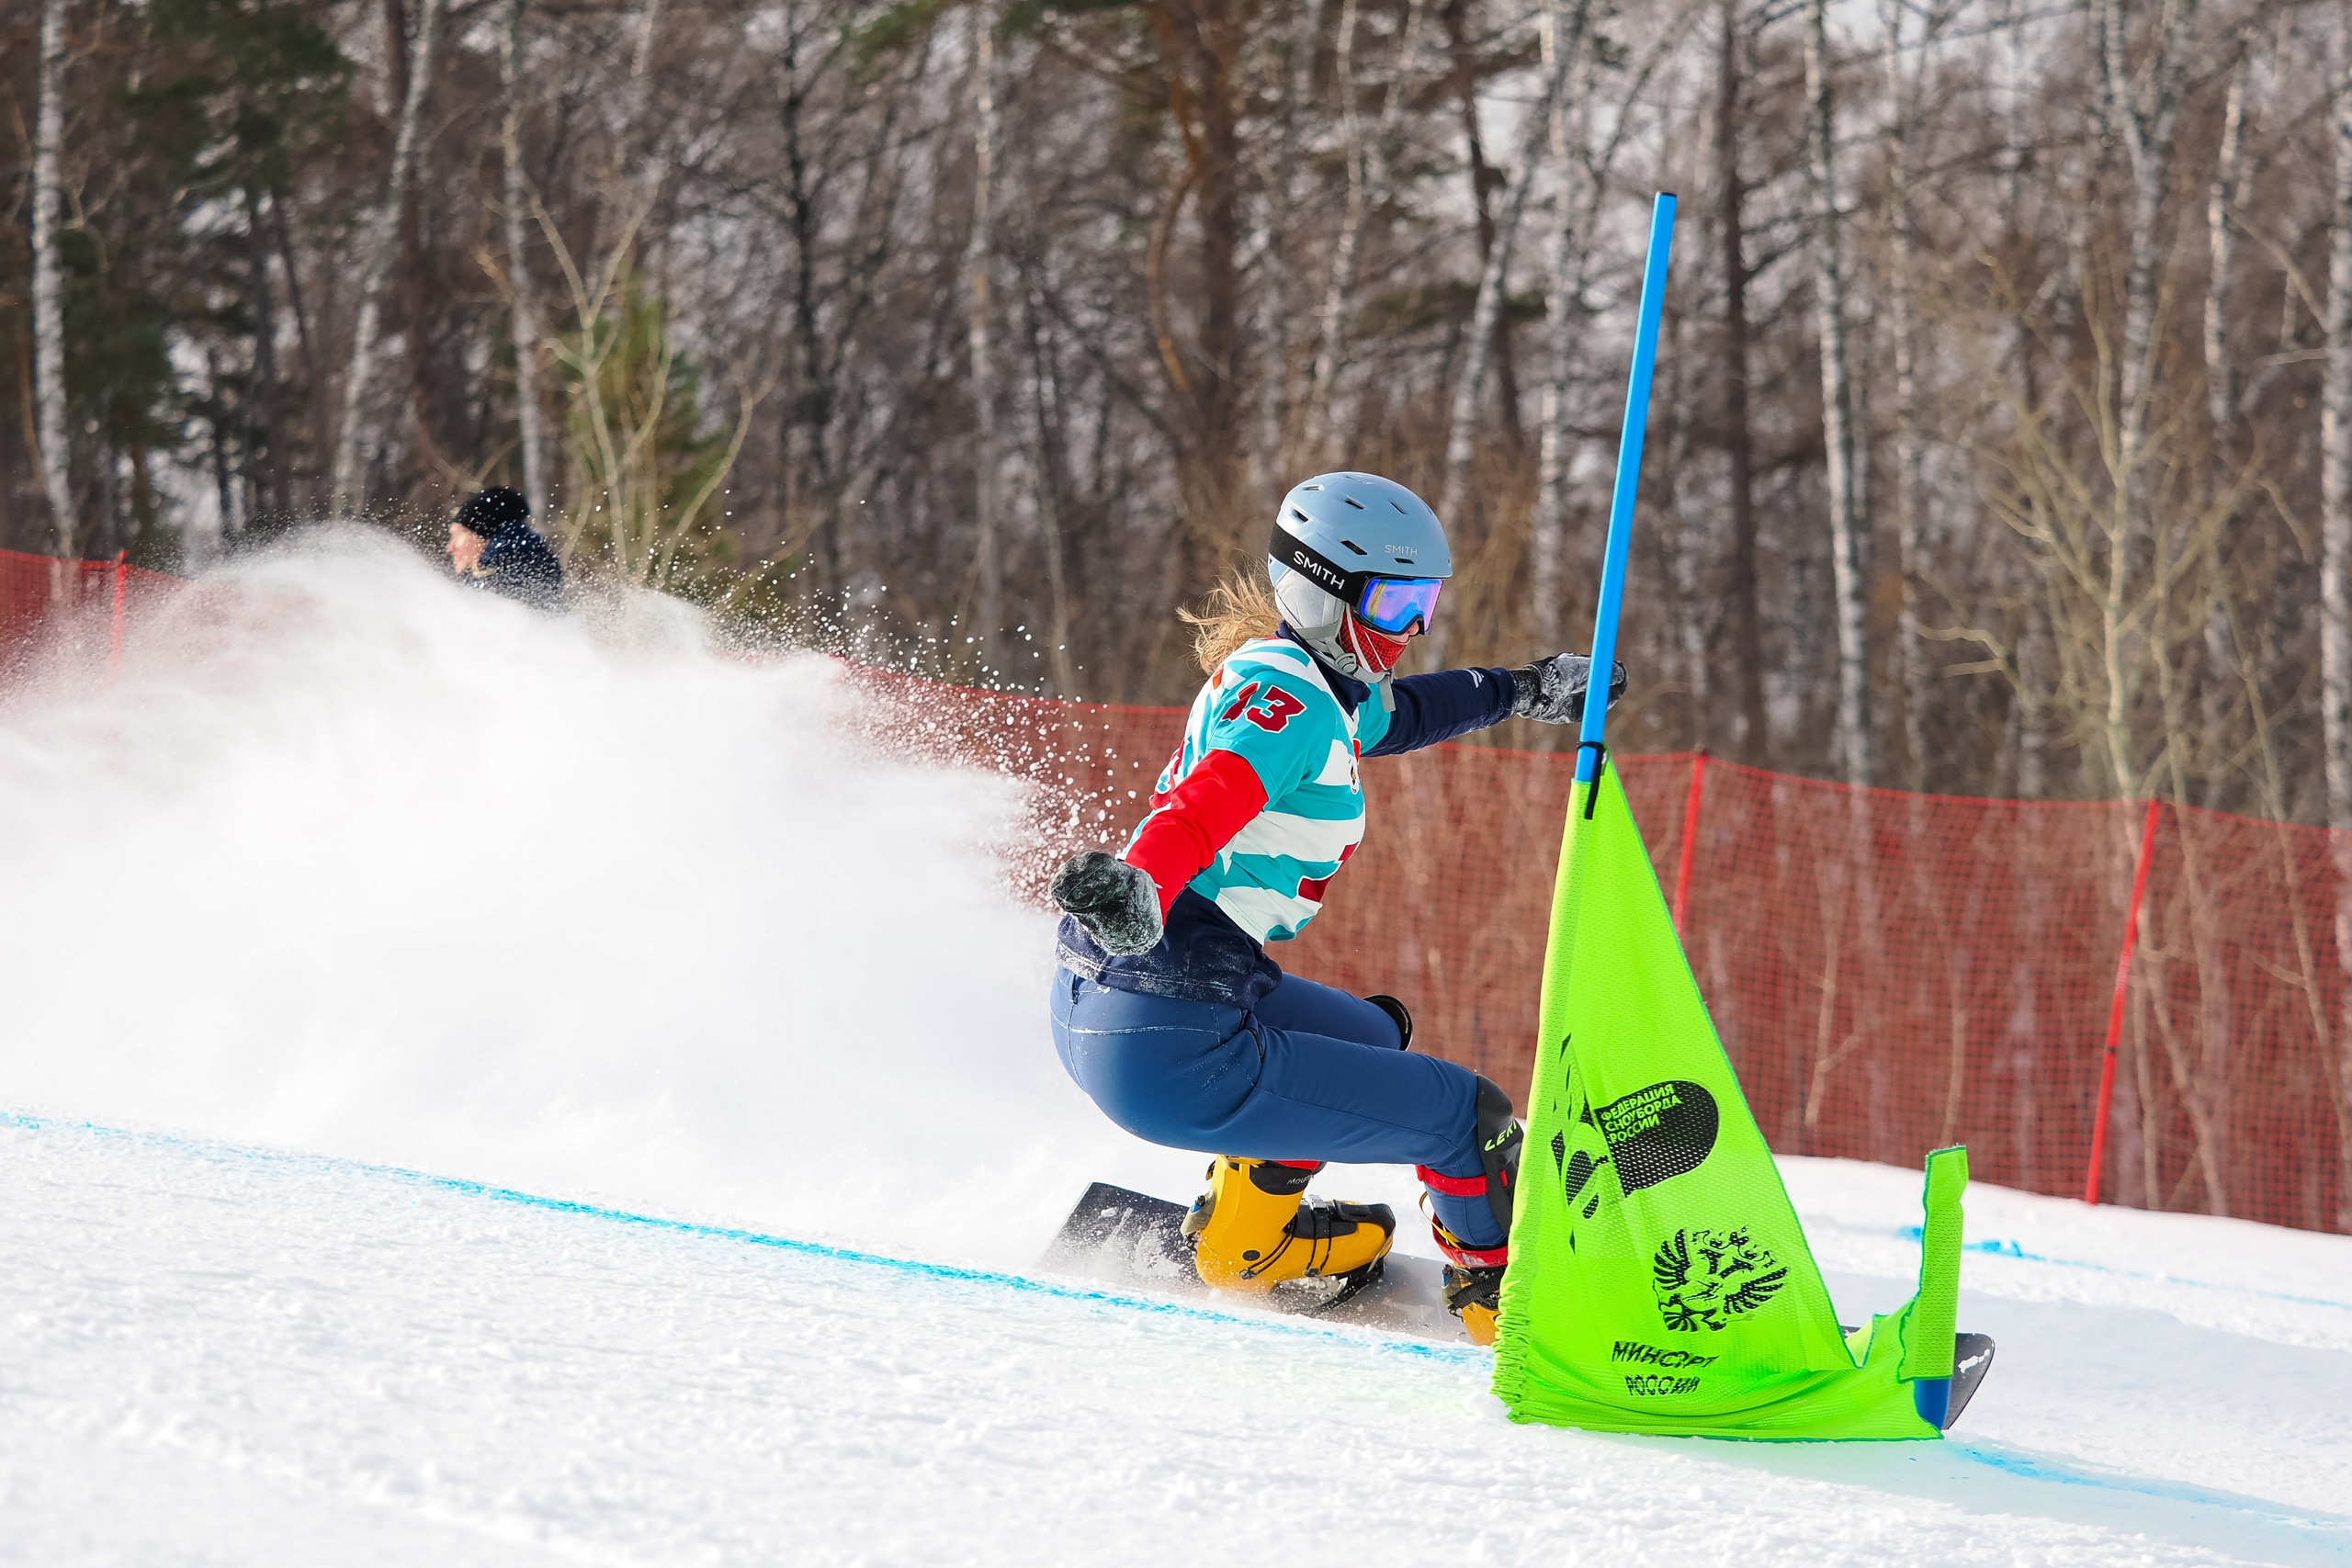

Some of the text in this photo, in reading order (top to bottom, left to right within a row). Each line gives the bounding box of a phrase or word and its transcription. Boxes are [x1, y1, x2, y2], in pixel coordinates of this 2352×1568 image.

[1293, 550, 1346, 590] SMITH
[1384, 544, 1418, 557] SMITH
[1221, 681, 1308, 734] 13
[1600, 1083, 1675, 1122] ФЕДЕРАЦИЯ
[1605, 1094, 1683, 1133] СНОУБОРДА
[1609, 1113, 1660, 1144] РОССИИ
